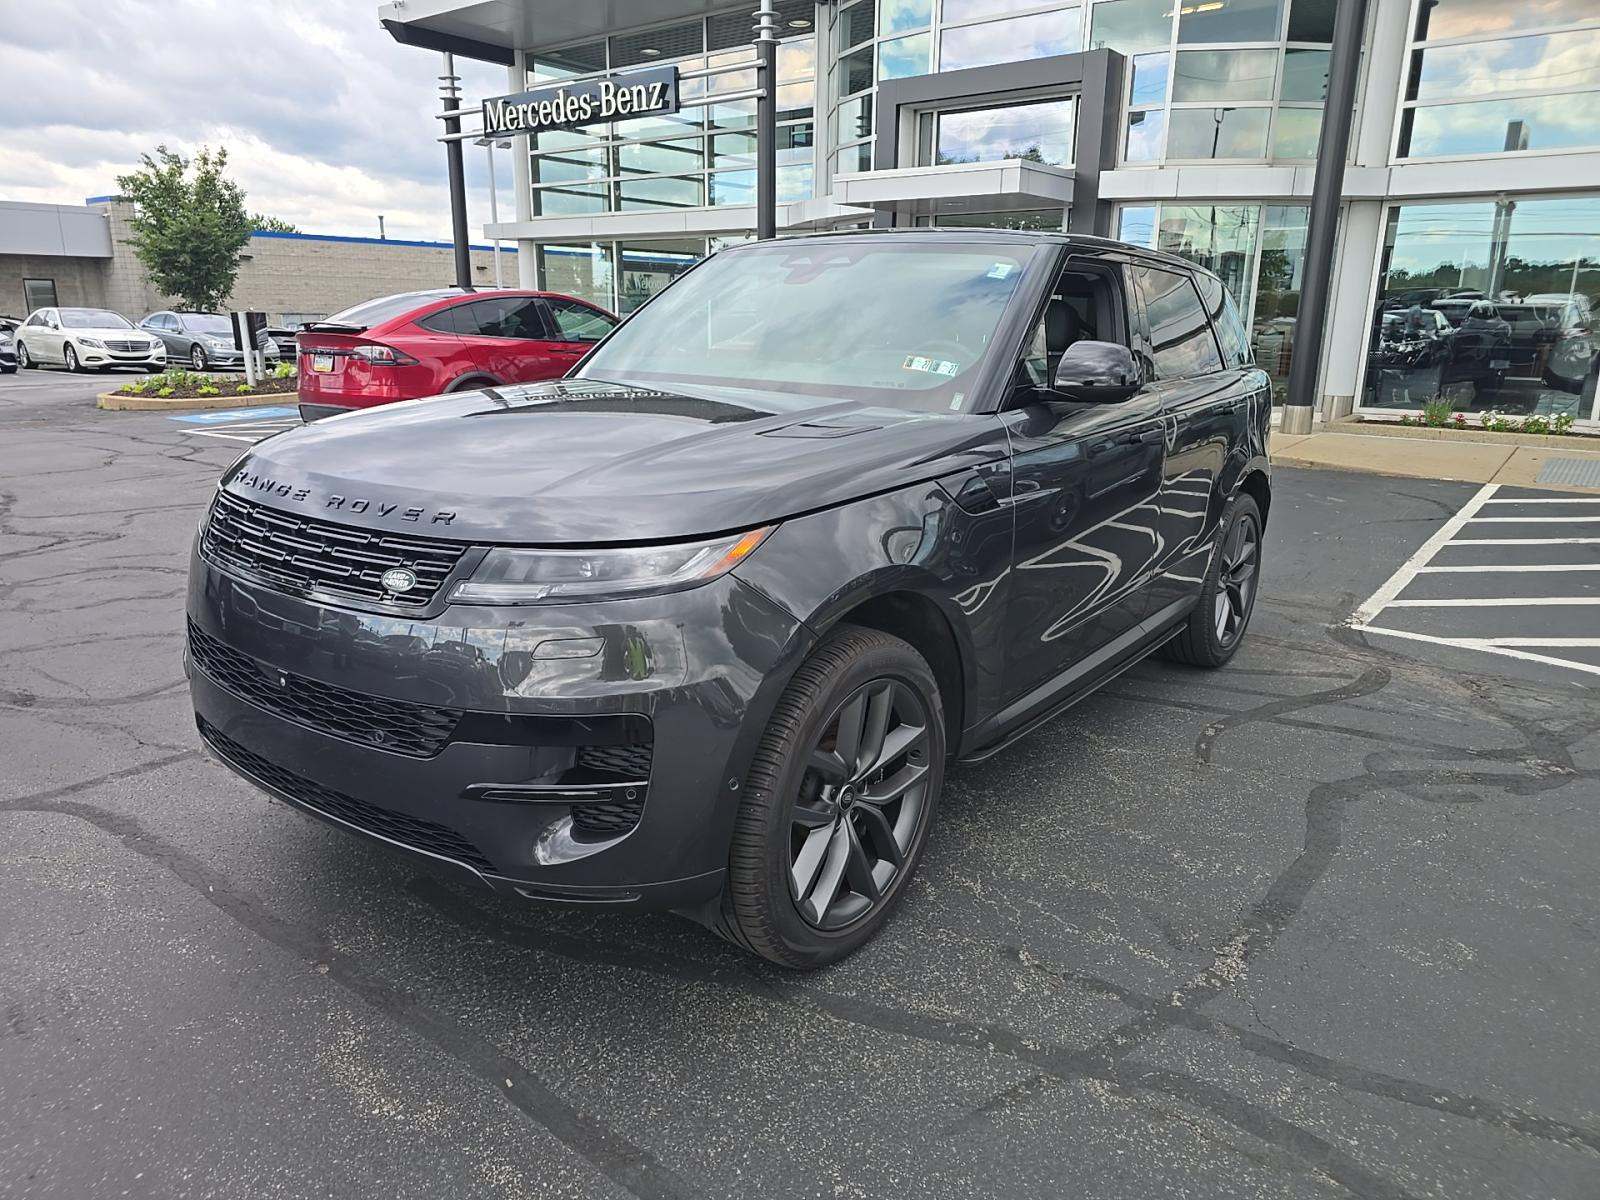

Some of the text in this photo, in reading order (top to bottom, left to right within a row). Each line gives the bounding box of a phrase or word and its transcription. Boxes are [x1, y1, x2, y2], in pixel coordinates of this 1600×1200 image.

[484, 81, 663, 133] Mercedes-Benz
[233, 470, 457, 526] RANGE ROVER
